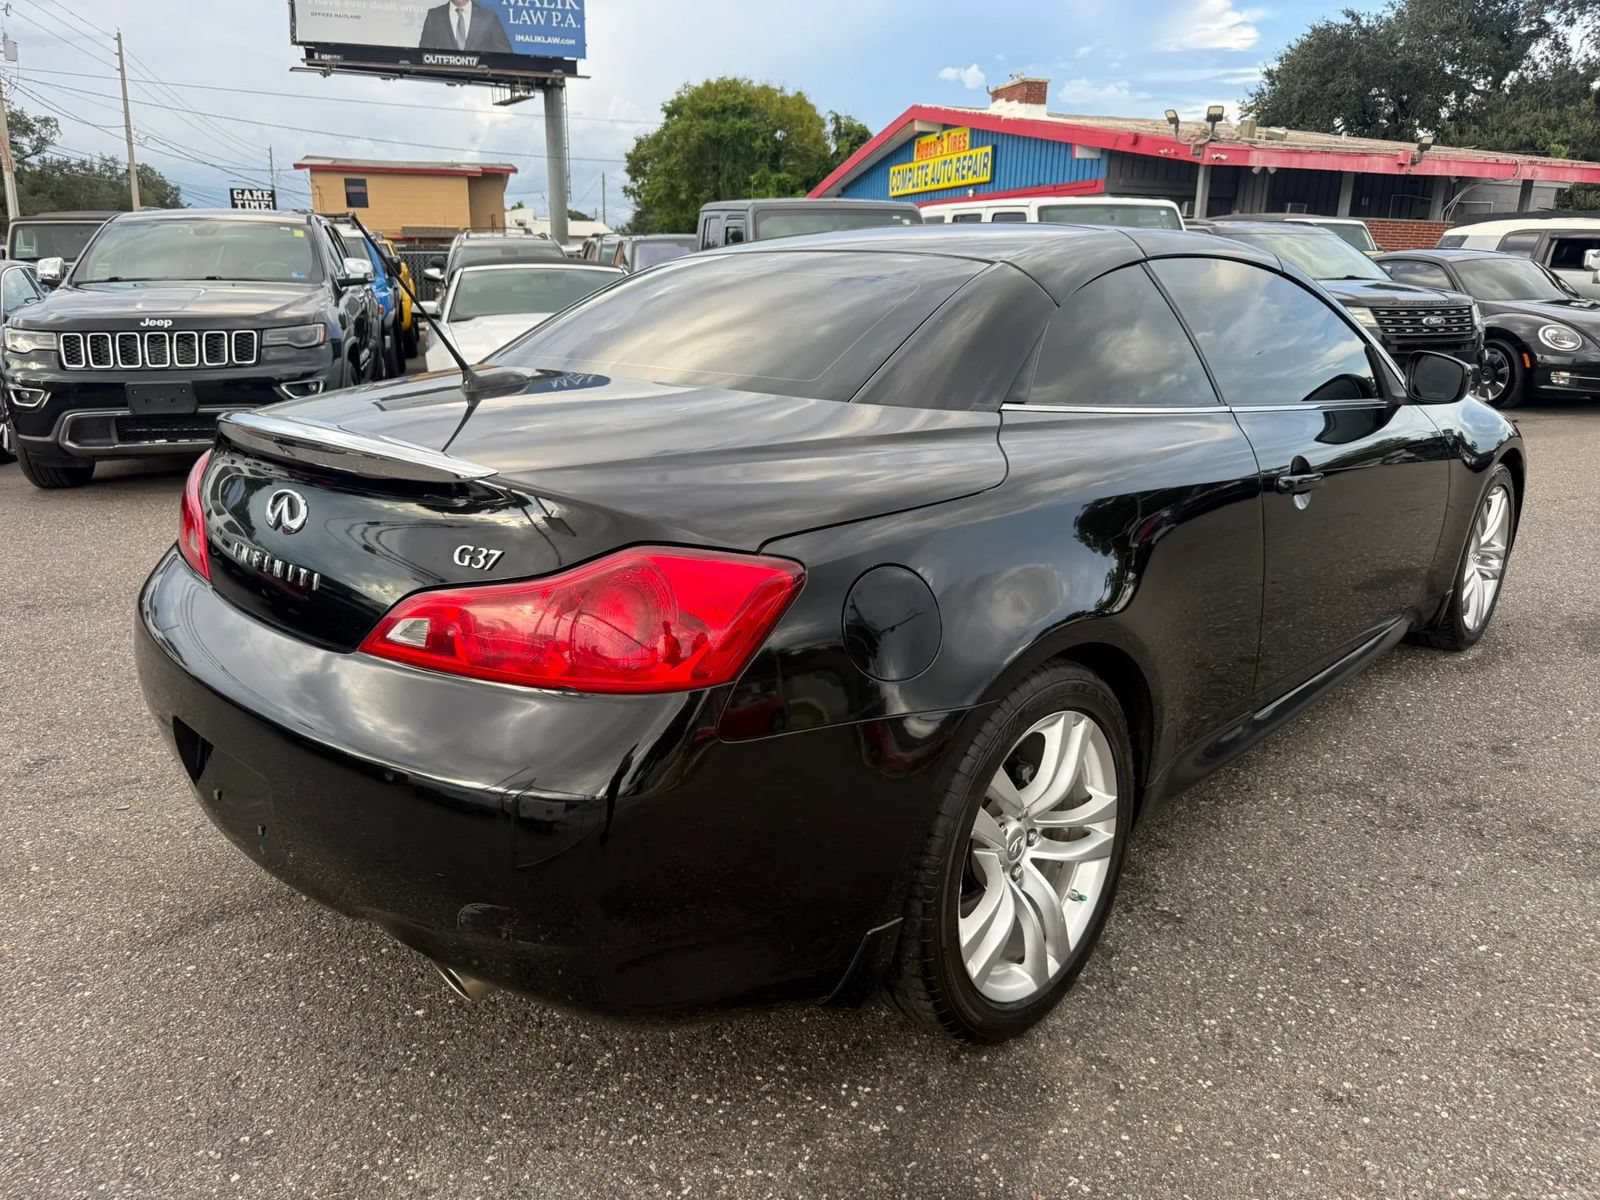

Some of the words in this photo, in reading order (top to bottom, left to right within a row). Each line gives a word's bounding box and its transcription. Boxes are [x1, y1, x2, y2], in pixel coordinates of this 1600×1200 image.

[508, 8, 547, 25] LAW
[552, 11, 581, 28] P.A.
[891, 164, 929, 192] COMPLETE
[931, 158, 953, 185] AUTO
[955, 152, 990, 181] REPAIR
[233, 189, 273, 201] GAME
[140, 317, 173, 328] Jeep
[233, 542, 320, 591] INFINITI
[453, 544, 505, 571] G37
